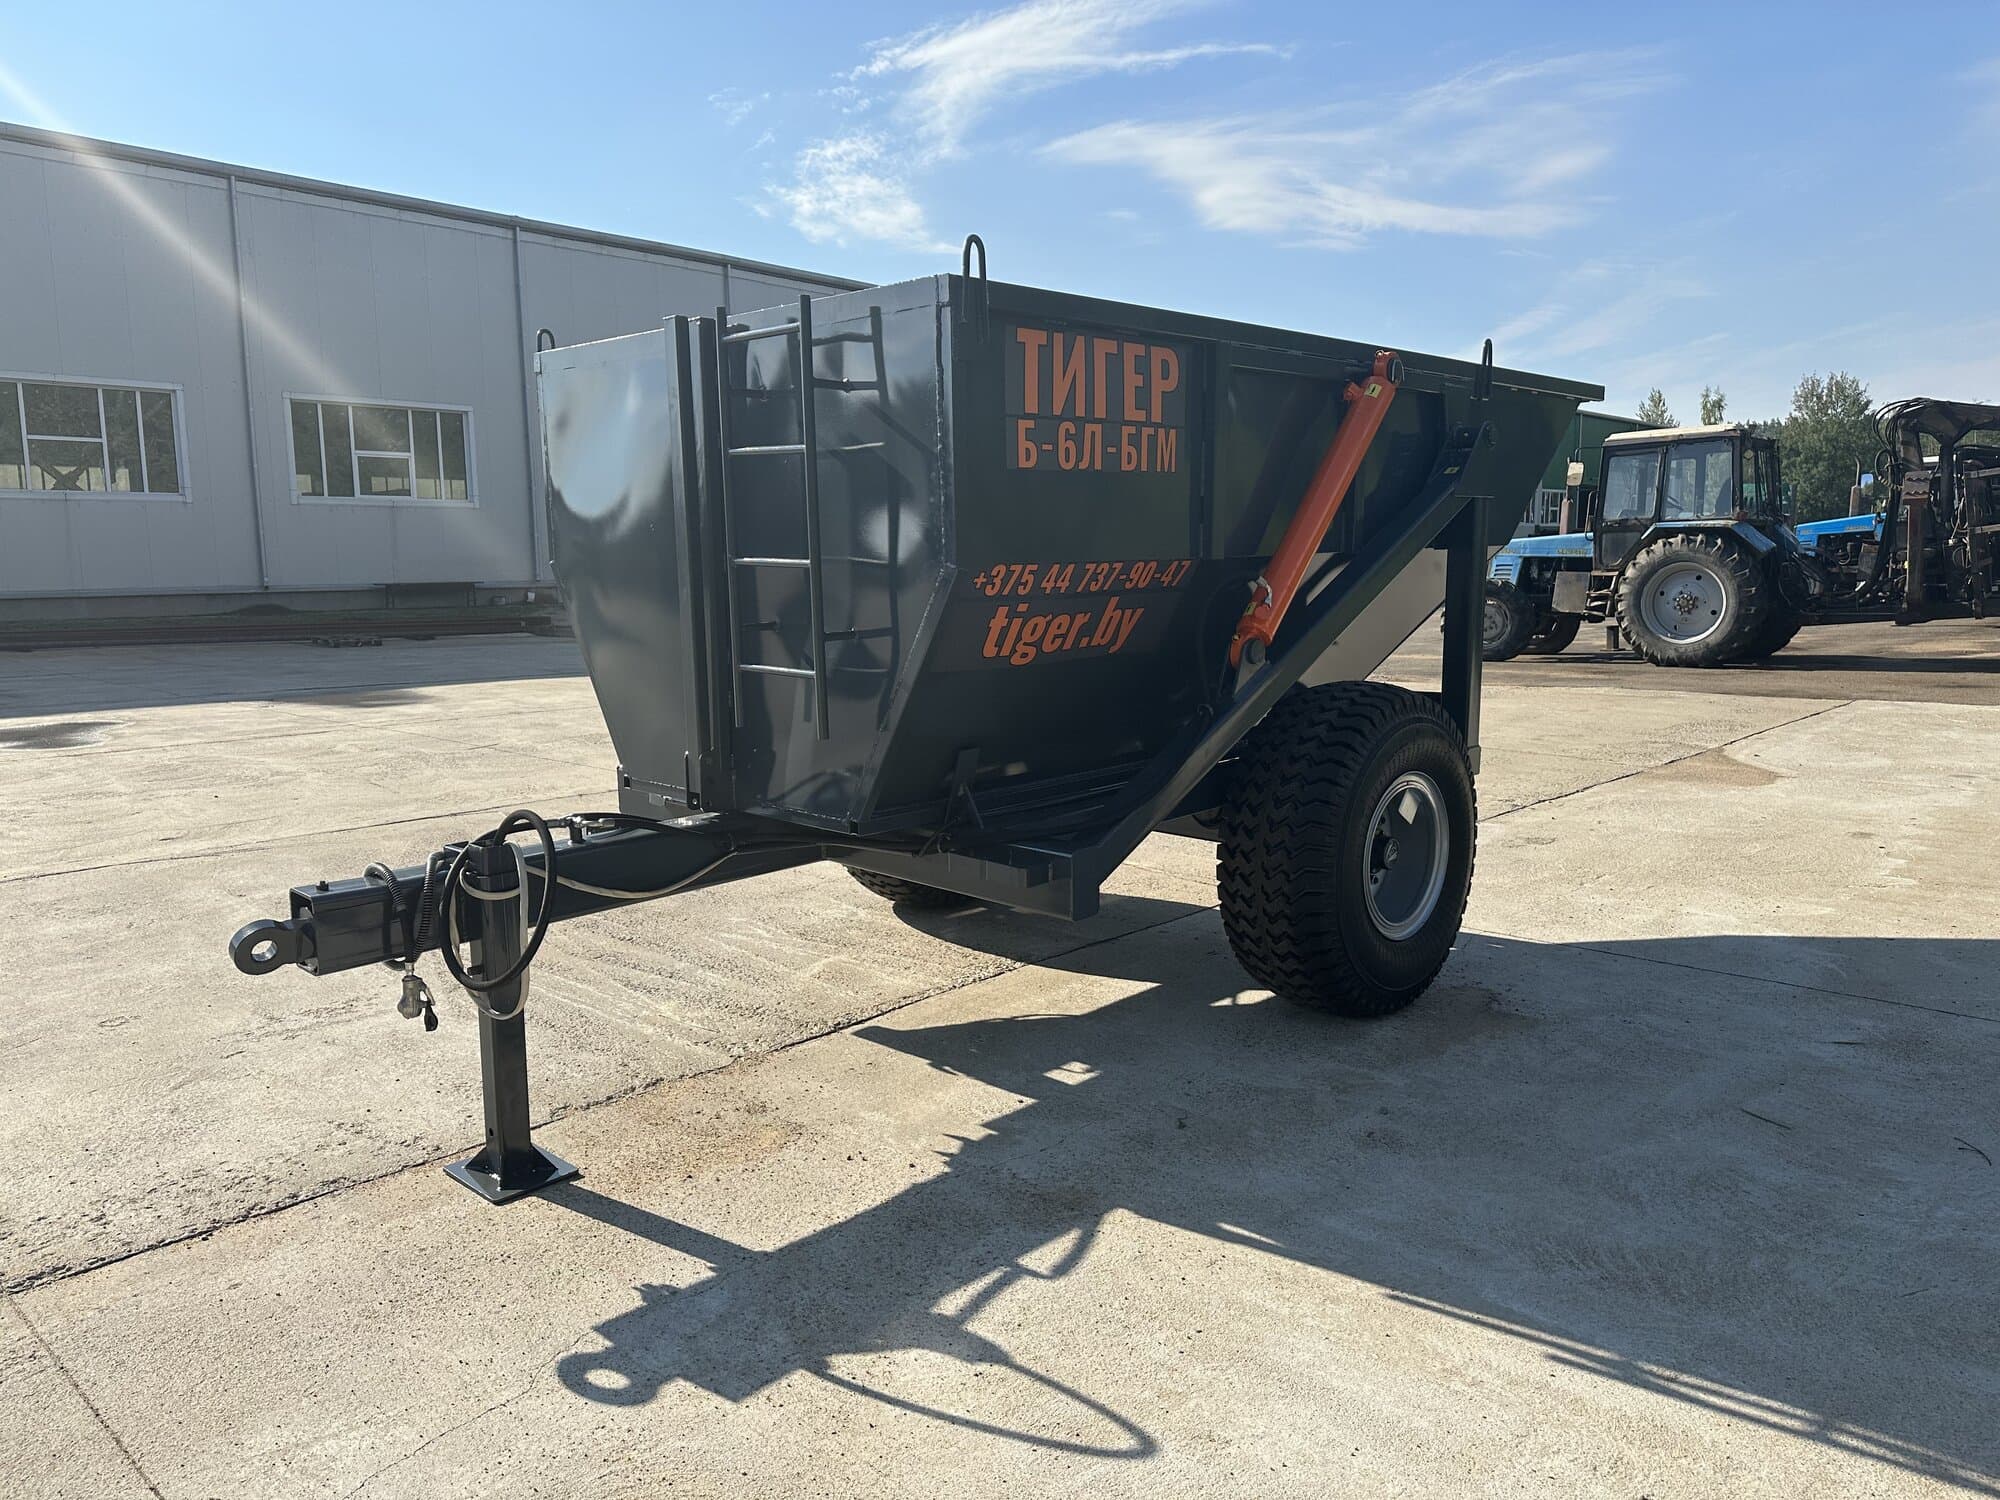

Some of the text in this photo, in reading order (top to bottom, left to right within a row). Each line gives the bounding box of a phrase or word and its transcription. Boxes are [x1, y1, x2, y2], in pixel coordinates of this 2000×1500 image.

[1016, 327, 1180, 423] ТИГЕР
[1017, 418, 1178, 473] Б-6Л-БГМ
[973, 560, 1192, 596] +375 44 737-90-47
[982, 596, 1145, 666] tiger.by
